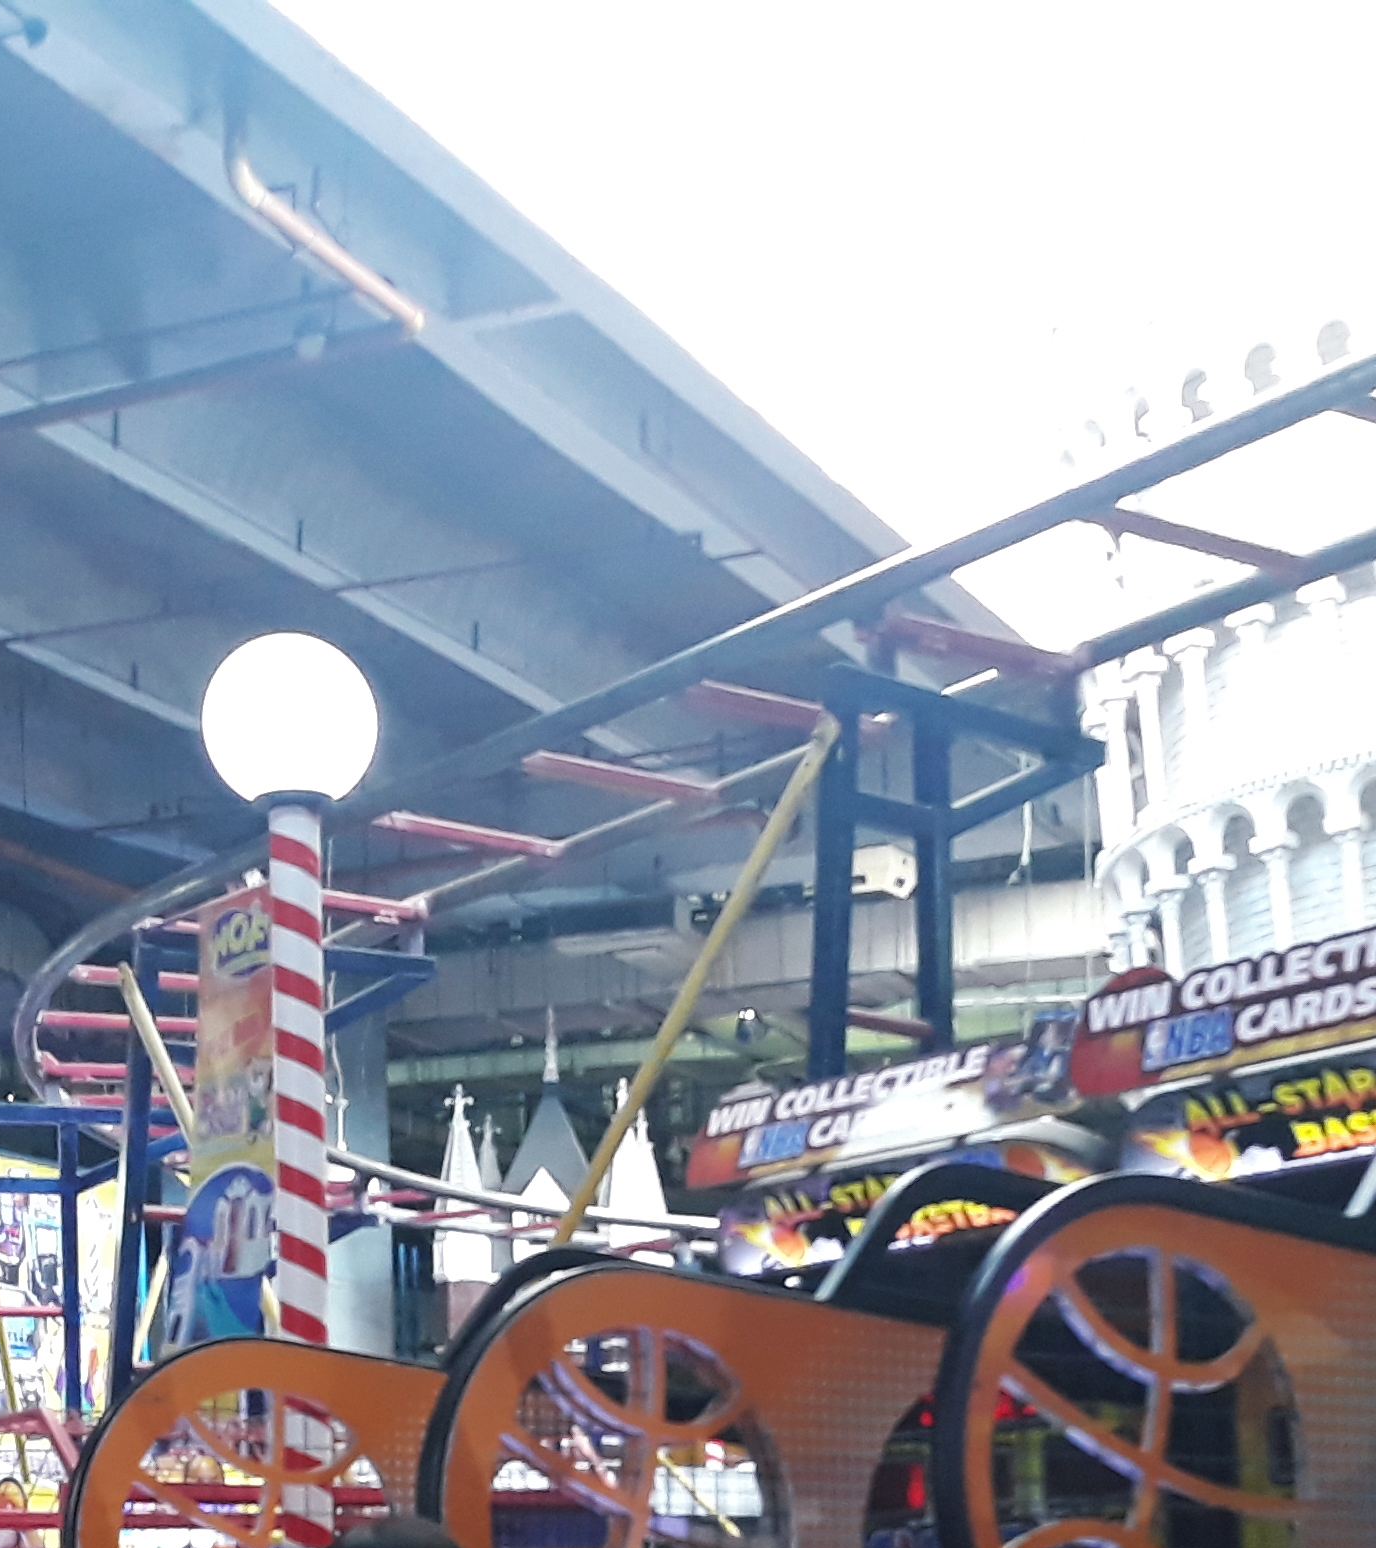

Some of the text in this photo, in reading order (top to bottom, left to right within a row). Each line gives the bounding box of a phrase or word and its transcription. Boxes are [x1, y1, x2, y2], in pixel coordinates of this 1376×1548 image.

[1087, 981, 1173, 1034] WIN
[705, 1095, 772, 1138] WIN
[774, 1044, 991, 1120] COLLECTIBLE
